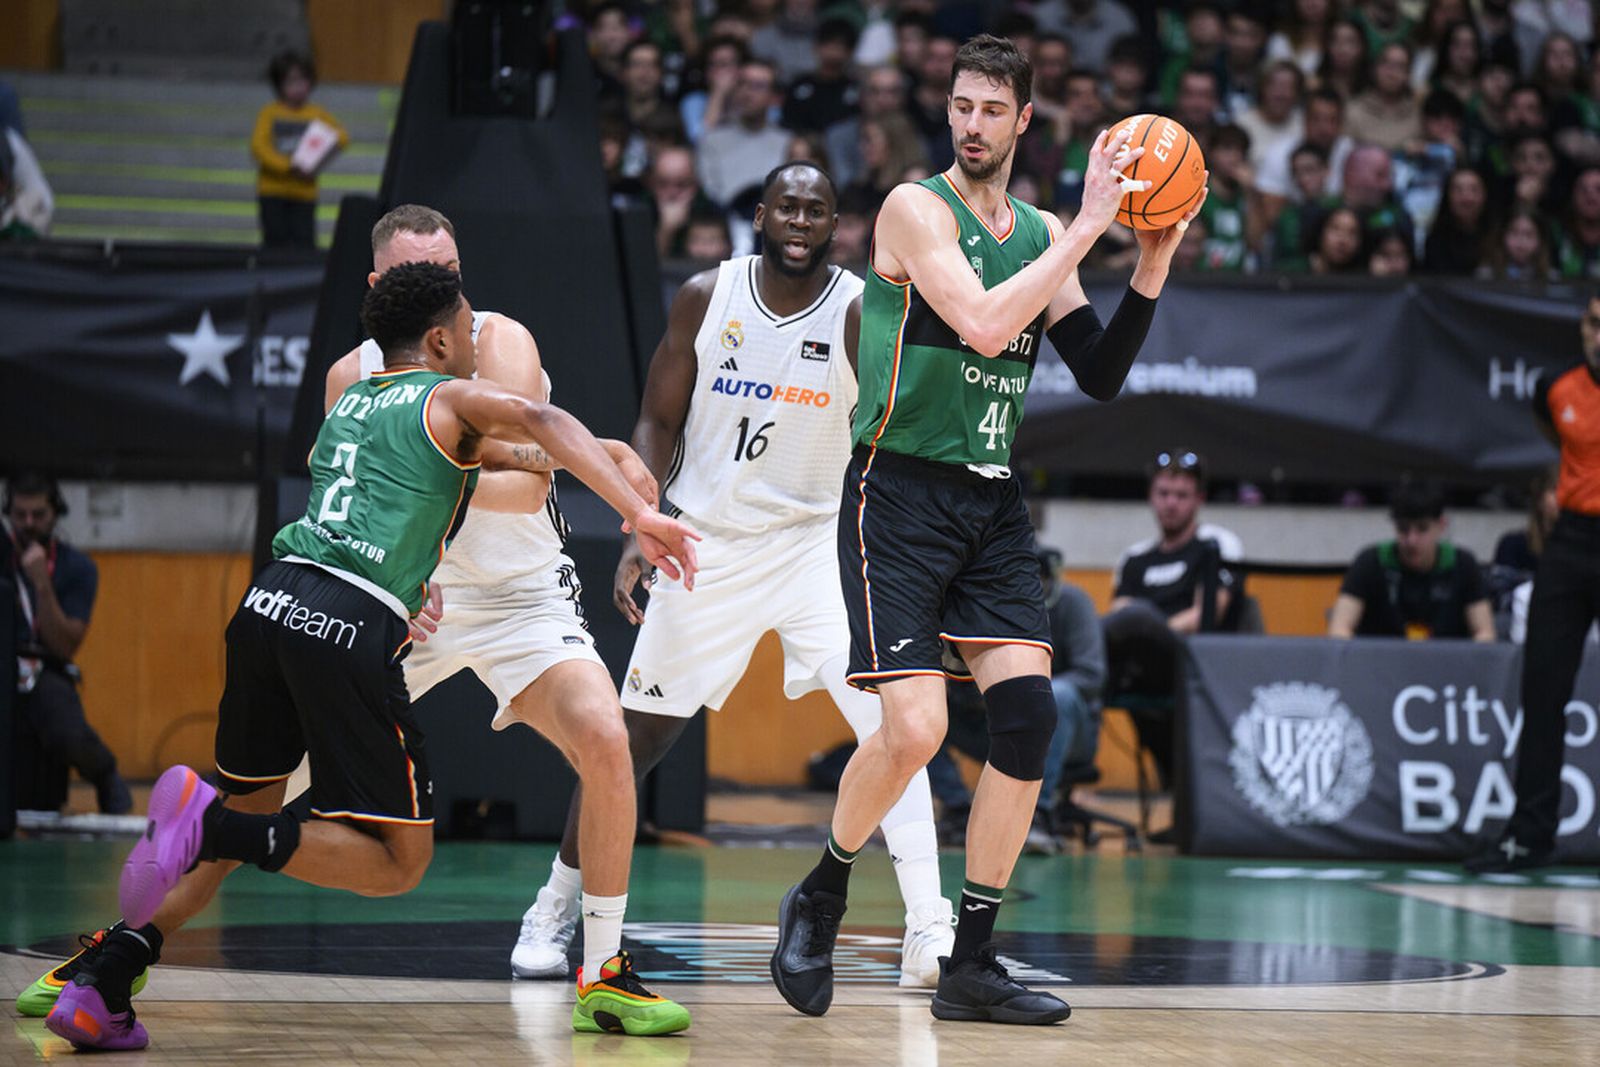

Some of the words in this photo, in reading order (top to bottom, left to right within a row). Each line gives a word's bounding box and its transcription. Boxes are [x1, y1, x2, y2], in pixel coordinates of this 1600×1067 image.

[711, 376, 831, 409] AUTOHERO
[960, 361, 1029, 395] OVENTU
[1126, 355, 1257, 398] emium
[326, 384, 426, 420] OTSON
[734, 416, 776, 462] 16
[318, 442, 360, 524] 2
[243, 586, 360, 650] vdfteam
[1391, 684, 1525, 759] City
